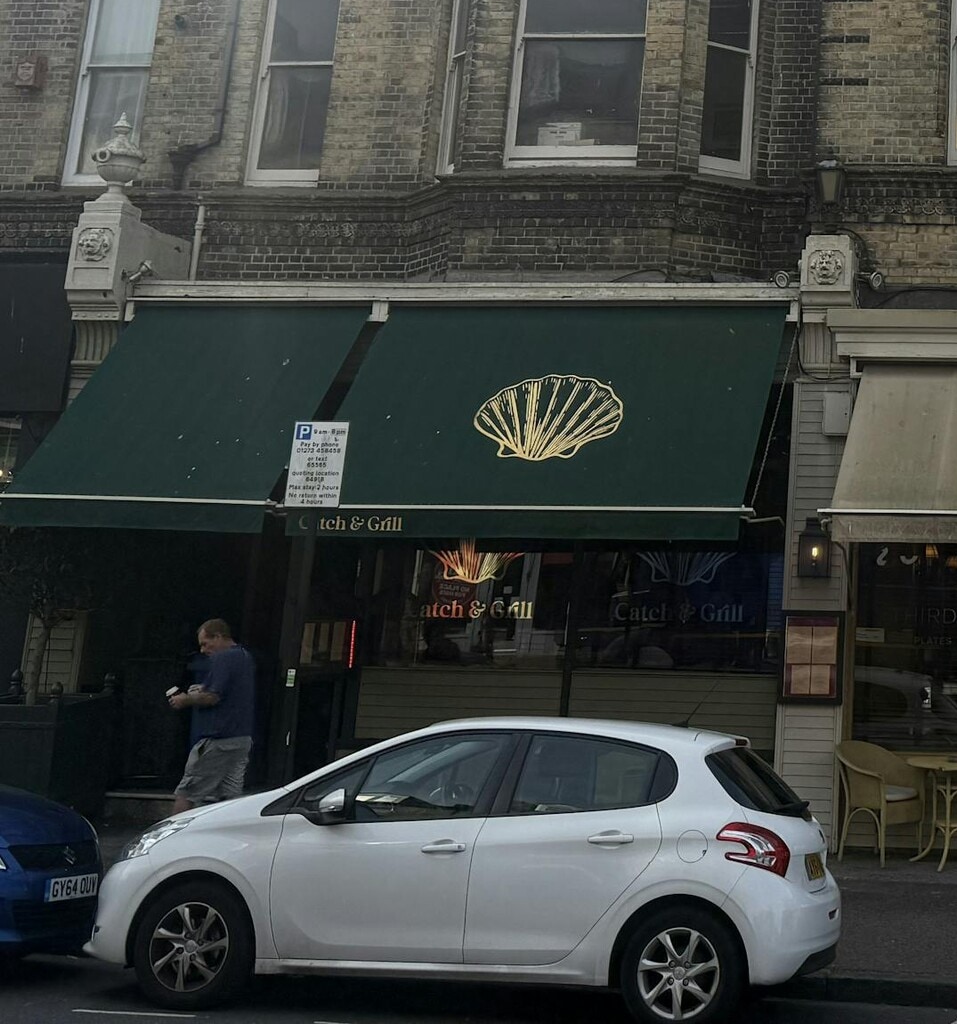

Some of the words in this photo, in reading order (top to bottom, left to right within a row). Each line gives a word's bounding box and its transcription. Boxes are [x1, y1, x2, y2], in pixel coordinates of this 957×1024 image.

[299, 425, 311, 439] P
[298, 515, 346, 531] Ctch
[350, 515, 365, 531] &
[367, 515, 403, 532] Grill
[406, 599, 464, 619] atch
[468, 599, 486, 619] &
[489, 600, 534, 619] Grill
[700, 602, 744, 623] Grill
[52, 878, 79, 897] GY64
